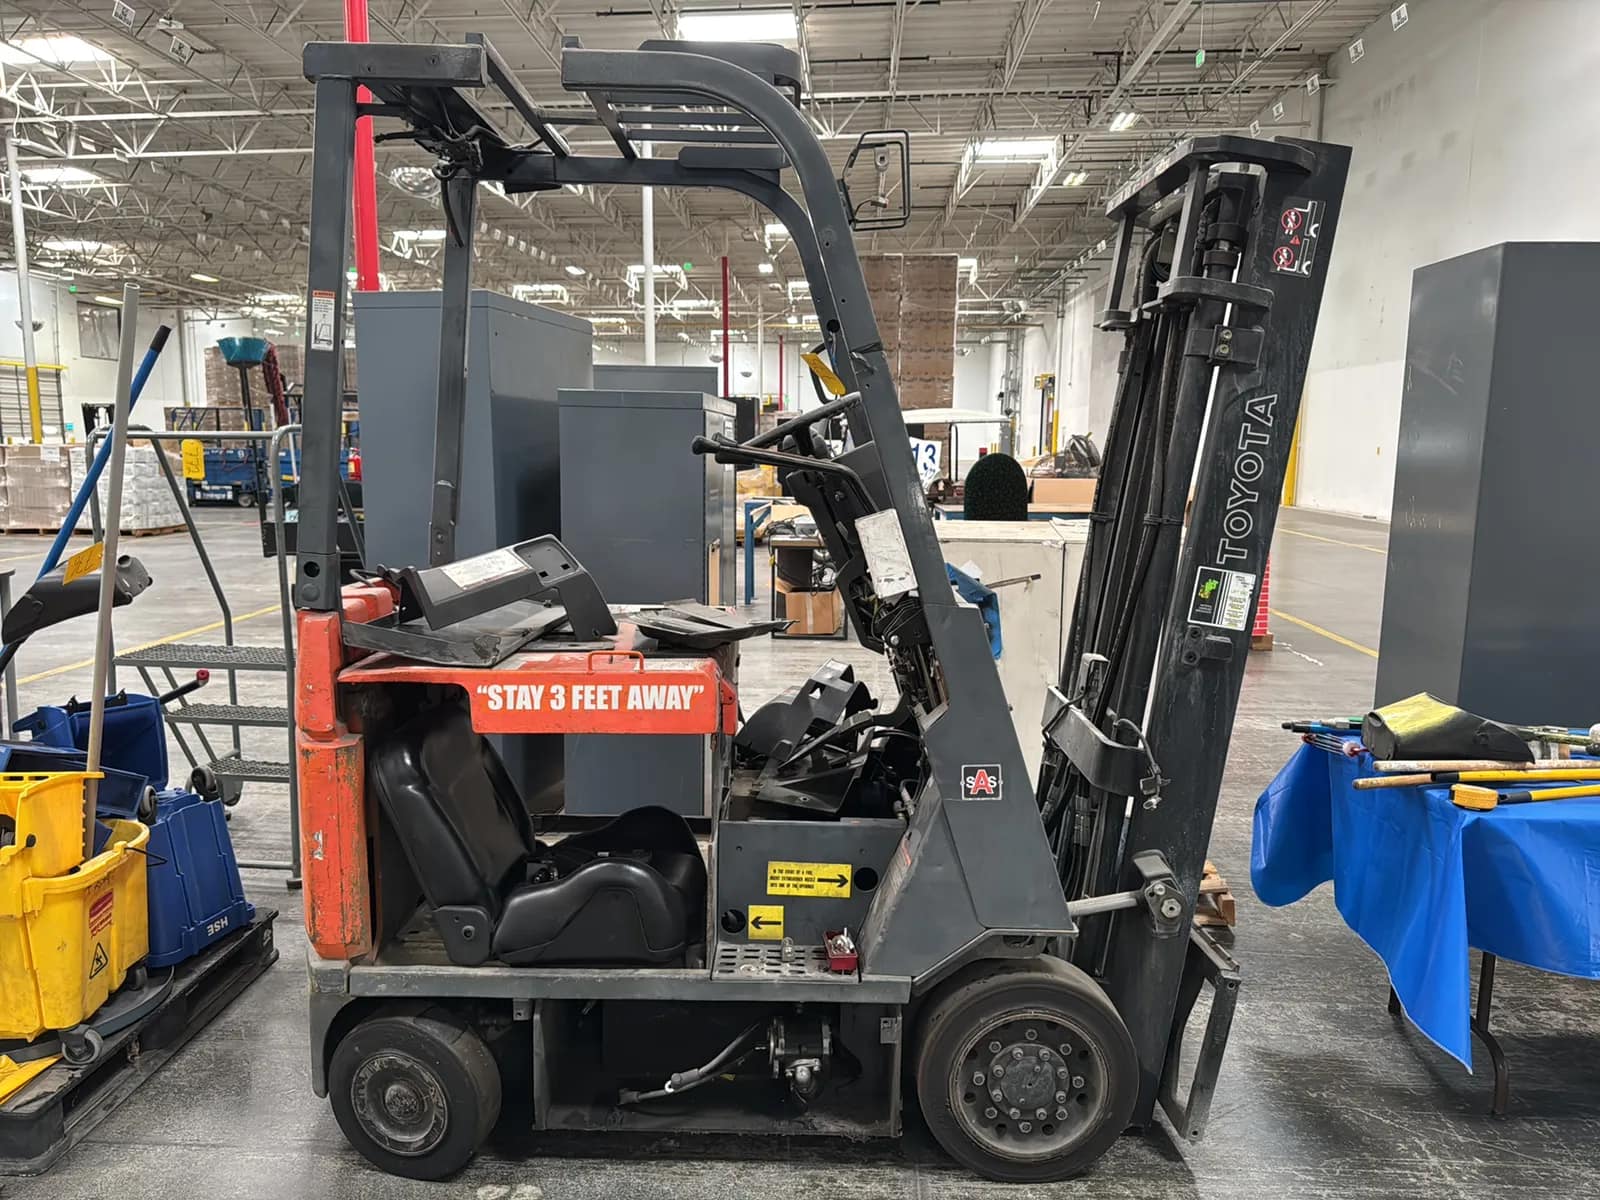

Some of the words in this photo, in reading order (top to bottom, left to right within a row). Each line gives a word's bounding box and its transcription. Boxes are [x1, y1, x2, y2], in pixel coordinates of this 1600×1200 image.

[1216, 394, 1278, 564] TOYOTA
[550, 684, 566, 711] 3
[571, 684, 622, 710] FEET
[966, 769, 997, 794] SAS
[206, 916, 229, 937] HSE
